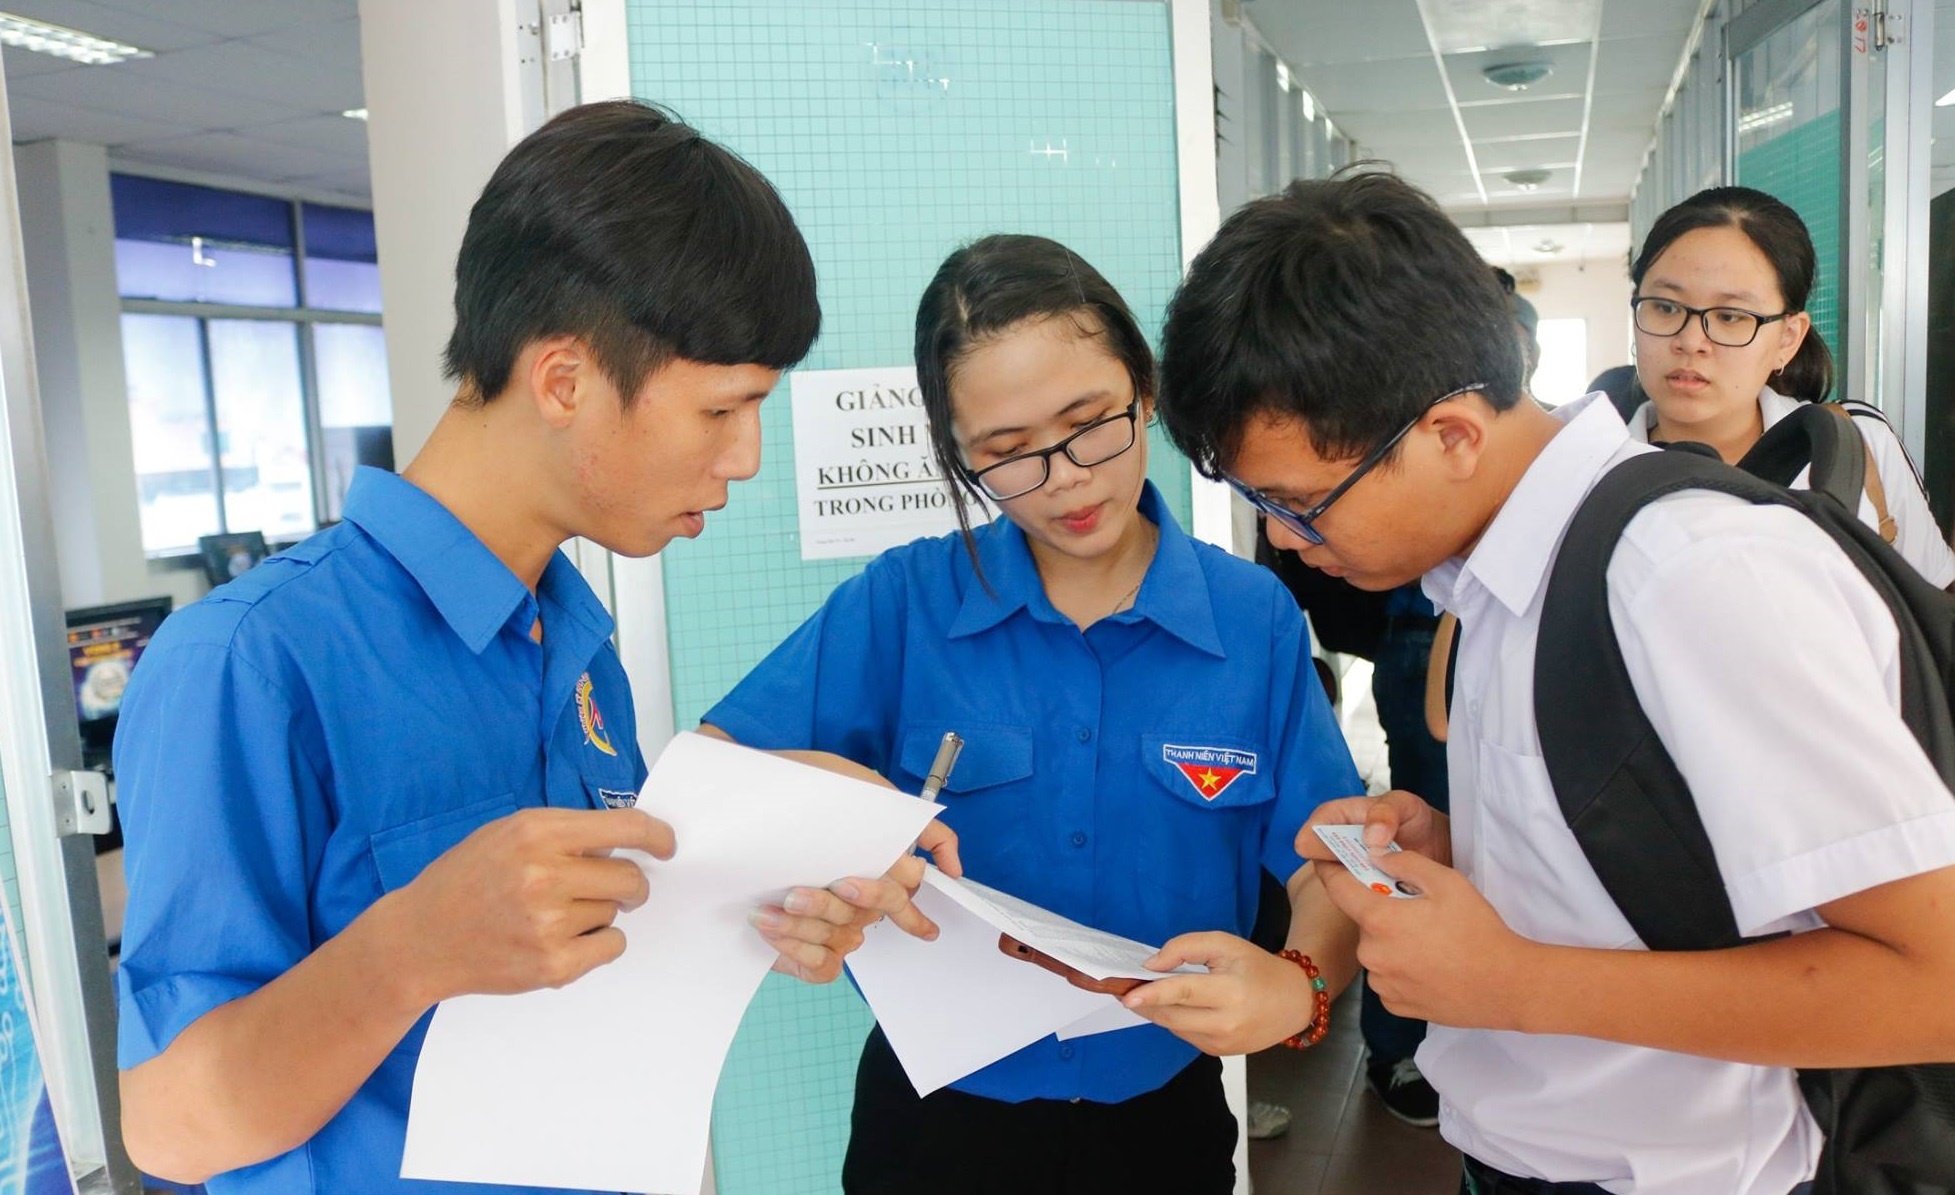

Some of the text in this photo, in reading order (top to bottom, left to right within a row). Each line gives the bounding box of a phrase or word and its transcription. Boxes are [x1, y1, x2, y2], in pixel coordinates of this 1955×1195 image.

[851, 425, 915, 449] SINH
[818, 458, 909, 485] KHÔNG
[814, 495, 893, 517] TRONG
[1165, 748, 1194, 760] THANH
[1236, 755, 1254, 767] NAM
